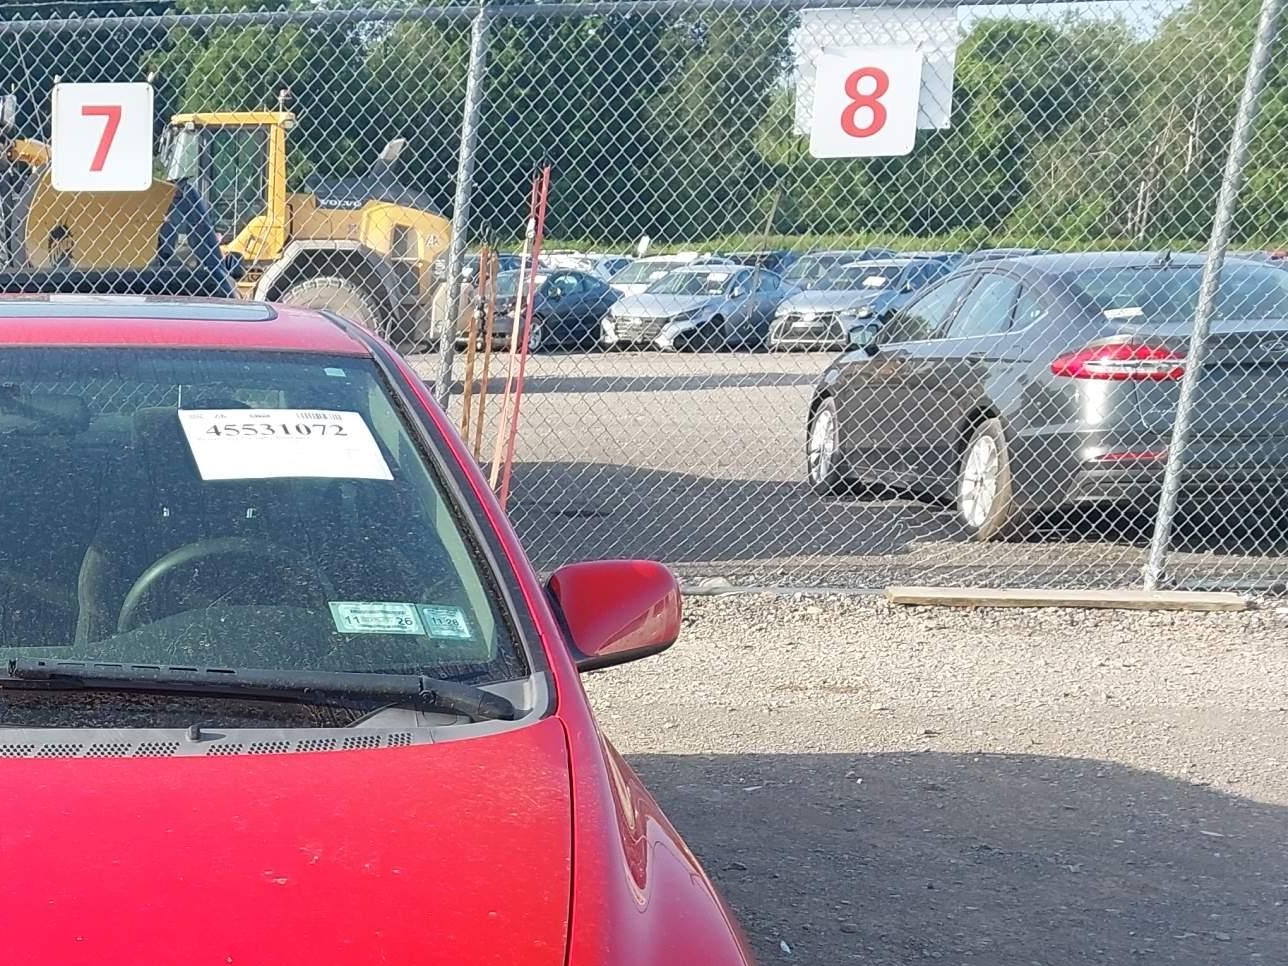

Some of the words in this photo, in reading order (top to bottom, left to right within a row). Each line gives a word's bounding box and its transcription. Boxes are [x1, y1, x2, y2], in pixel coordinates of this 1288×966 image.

[840, 66, 890, 138] 8
[81, 104, 122, 172] 7
[320, 199, 362, 208] VOLVO
[205, 422, 348, 437] 45531072
[344, 615, 361, 625] 11
[396, 616, 414, 626] 26
